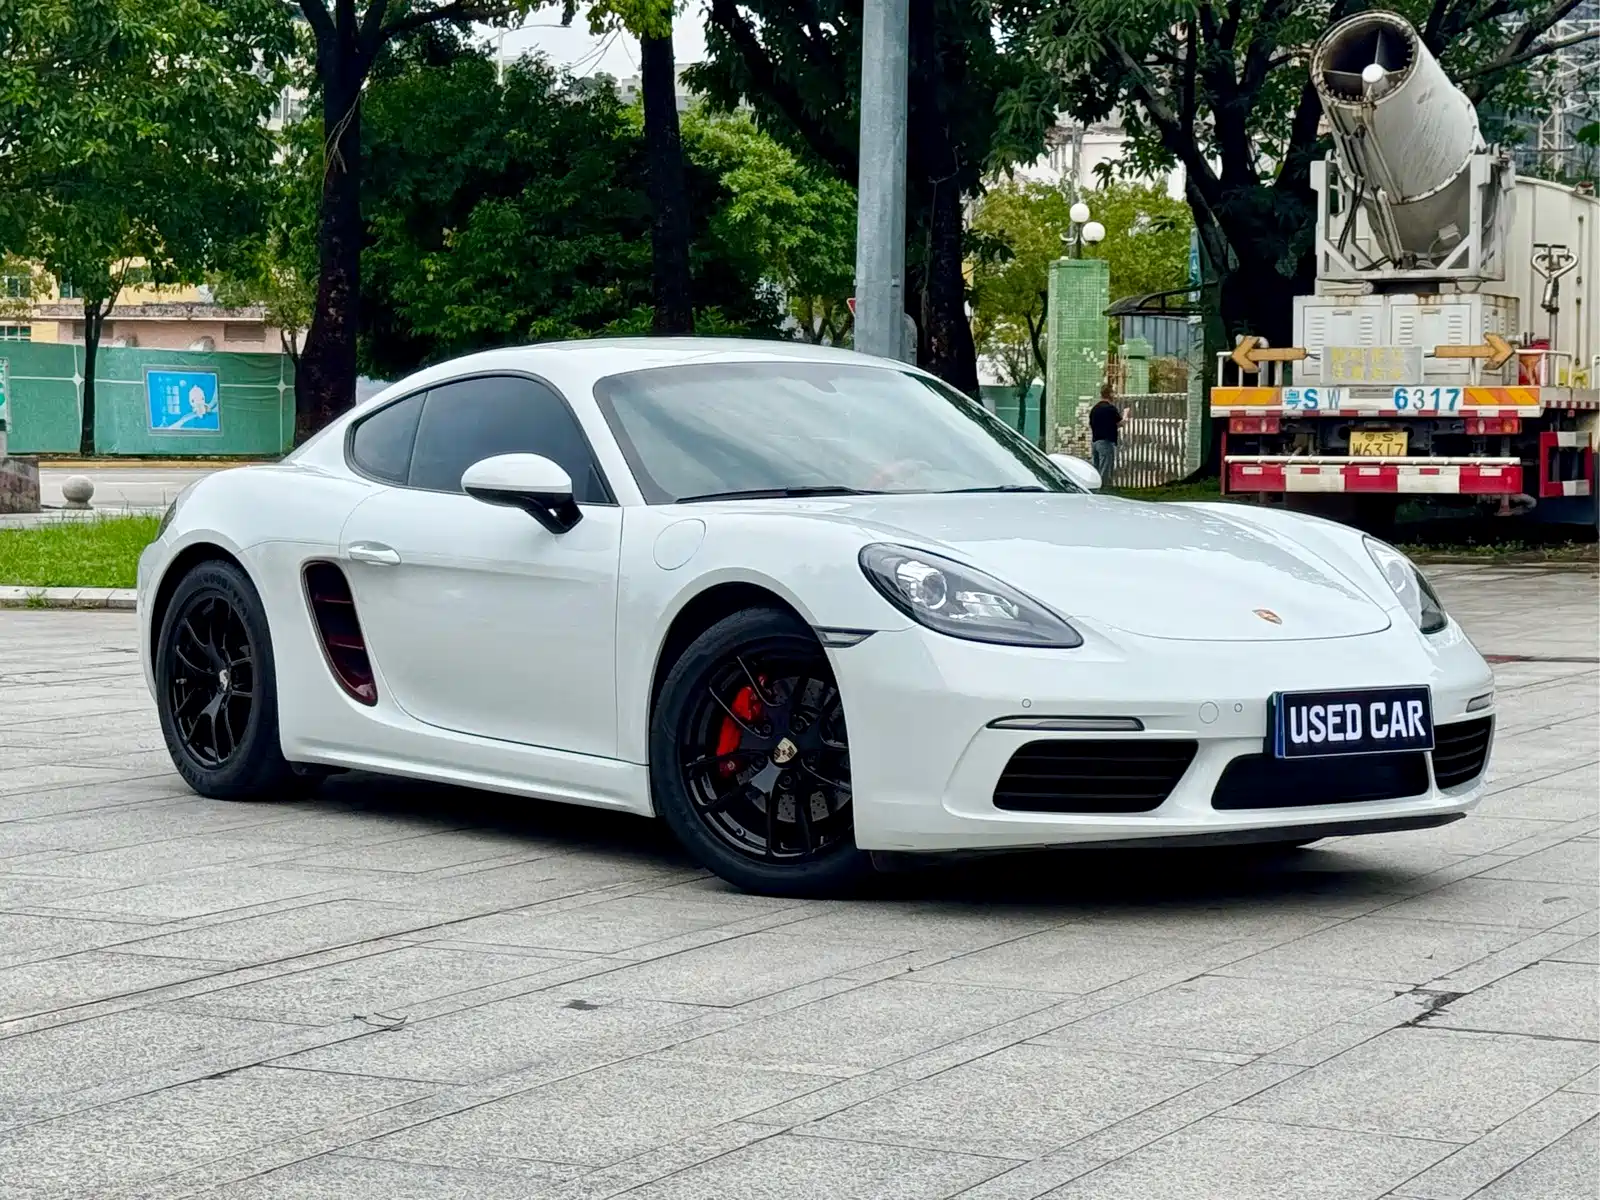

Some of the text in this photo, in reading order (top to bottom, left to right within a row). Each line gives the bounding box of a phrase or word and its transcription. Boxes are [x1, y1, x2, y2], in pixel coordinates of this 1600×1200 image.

[1393, 385, 1461, 411] 6317
[1352, 442, 1404, 456] W6317
[1290, 700, 1426, 743] USED CAR
